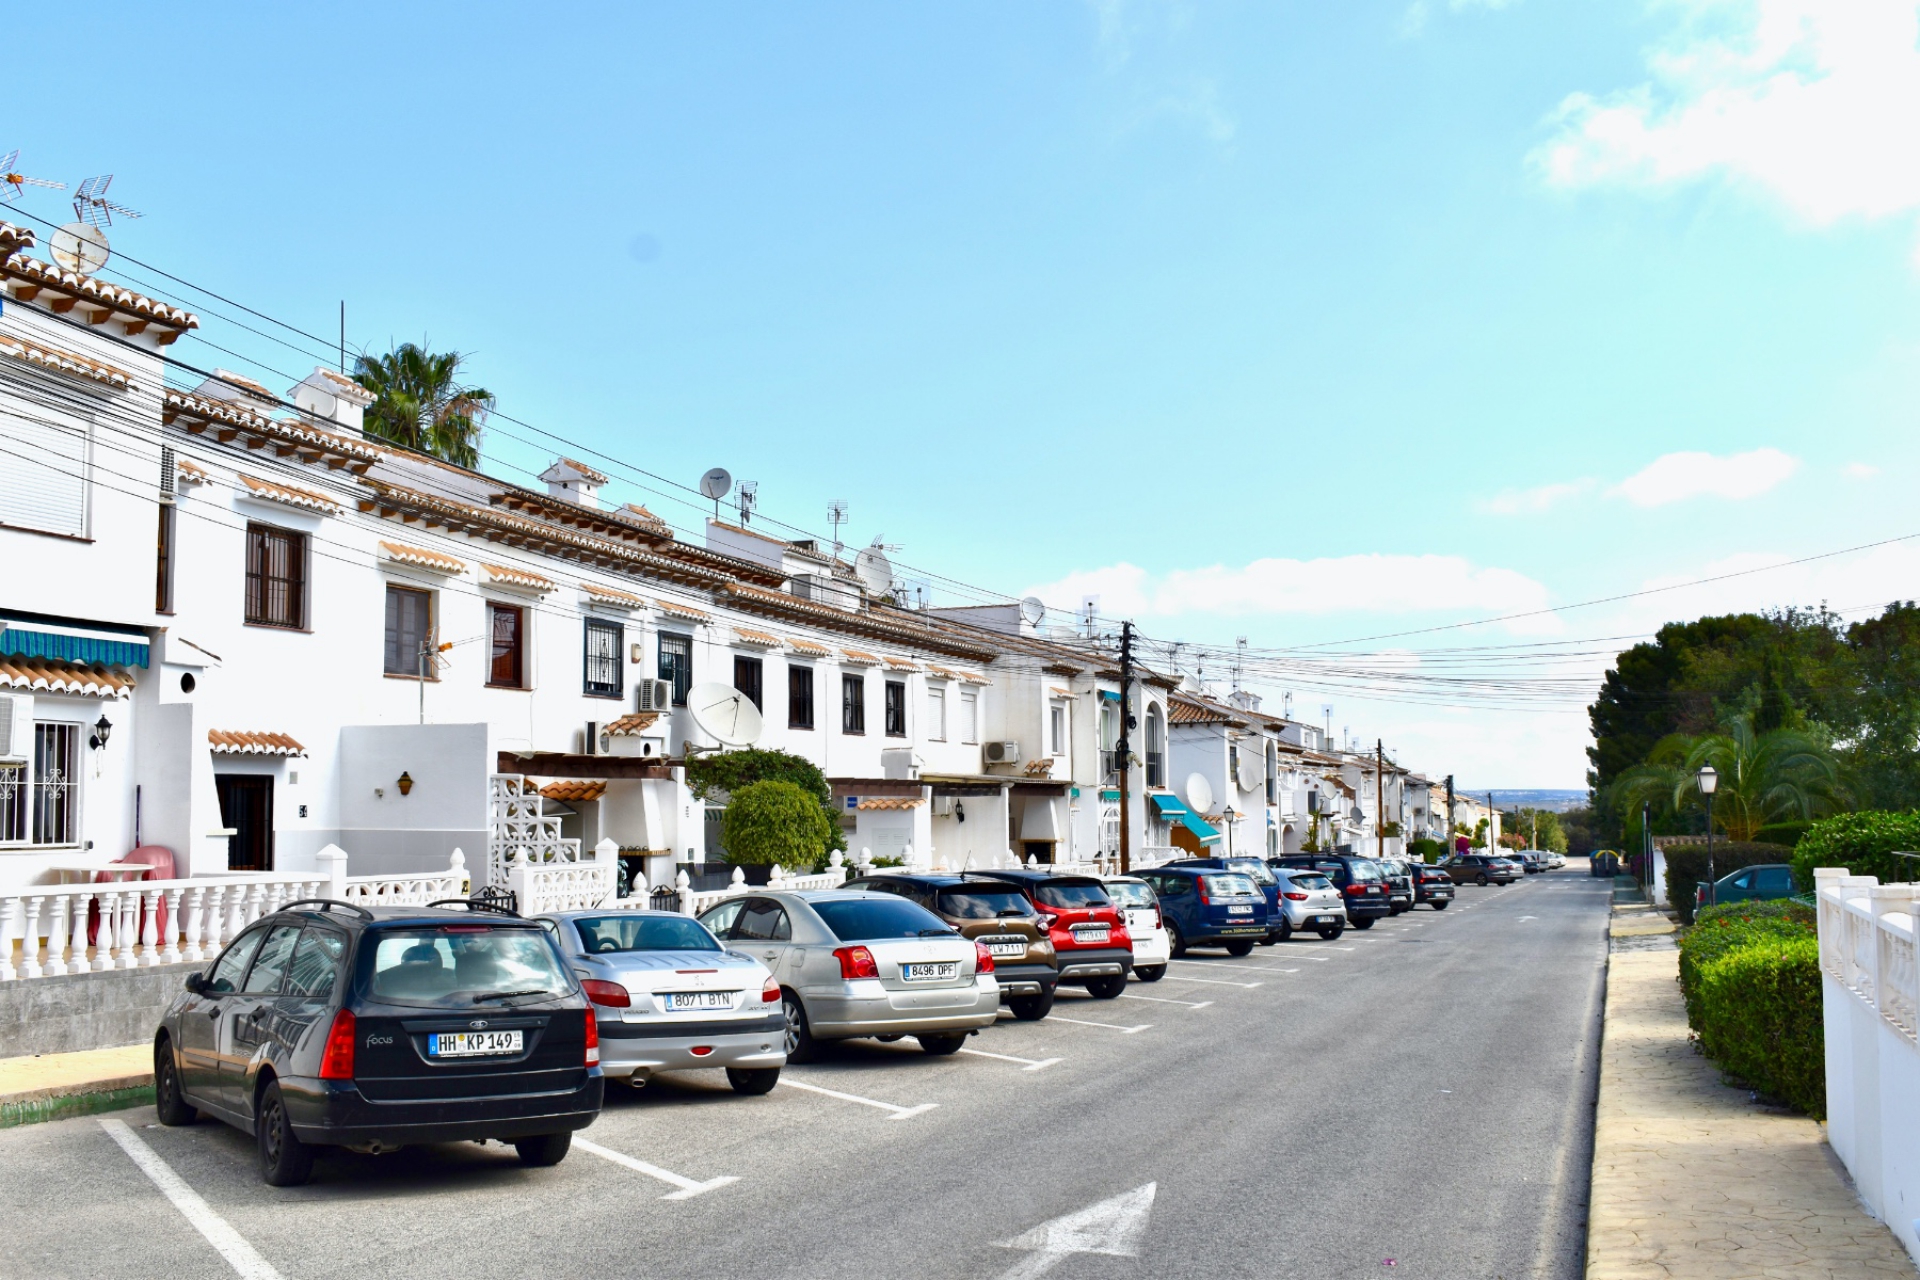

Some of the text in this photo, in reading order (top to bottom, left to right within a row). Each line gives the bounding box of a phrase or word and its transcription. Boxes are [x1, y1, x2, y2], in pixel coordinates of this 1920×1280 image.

[912, 964, 954, 976] 8496 DPF
[675, 993, 730, 1007] 8071 BTN
[439, 1035, 457, 1052] HH
[467, 1033, 484, 1050] KP
[488, 1033, 513, 1050] 149
